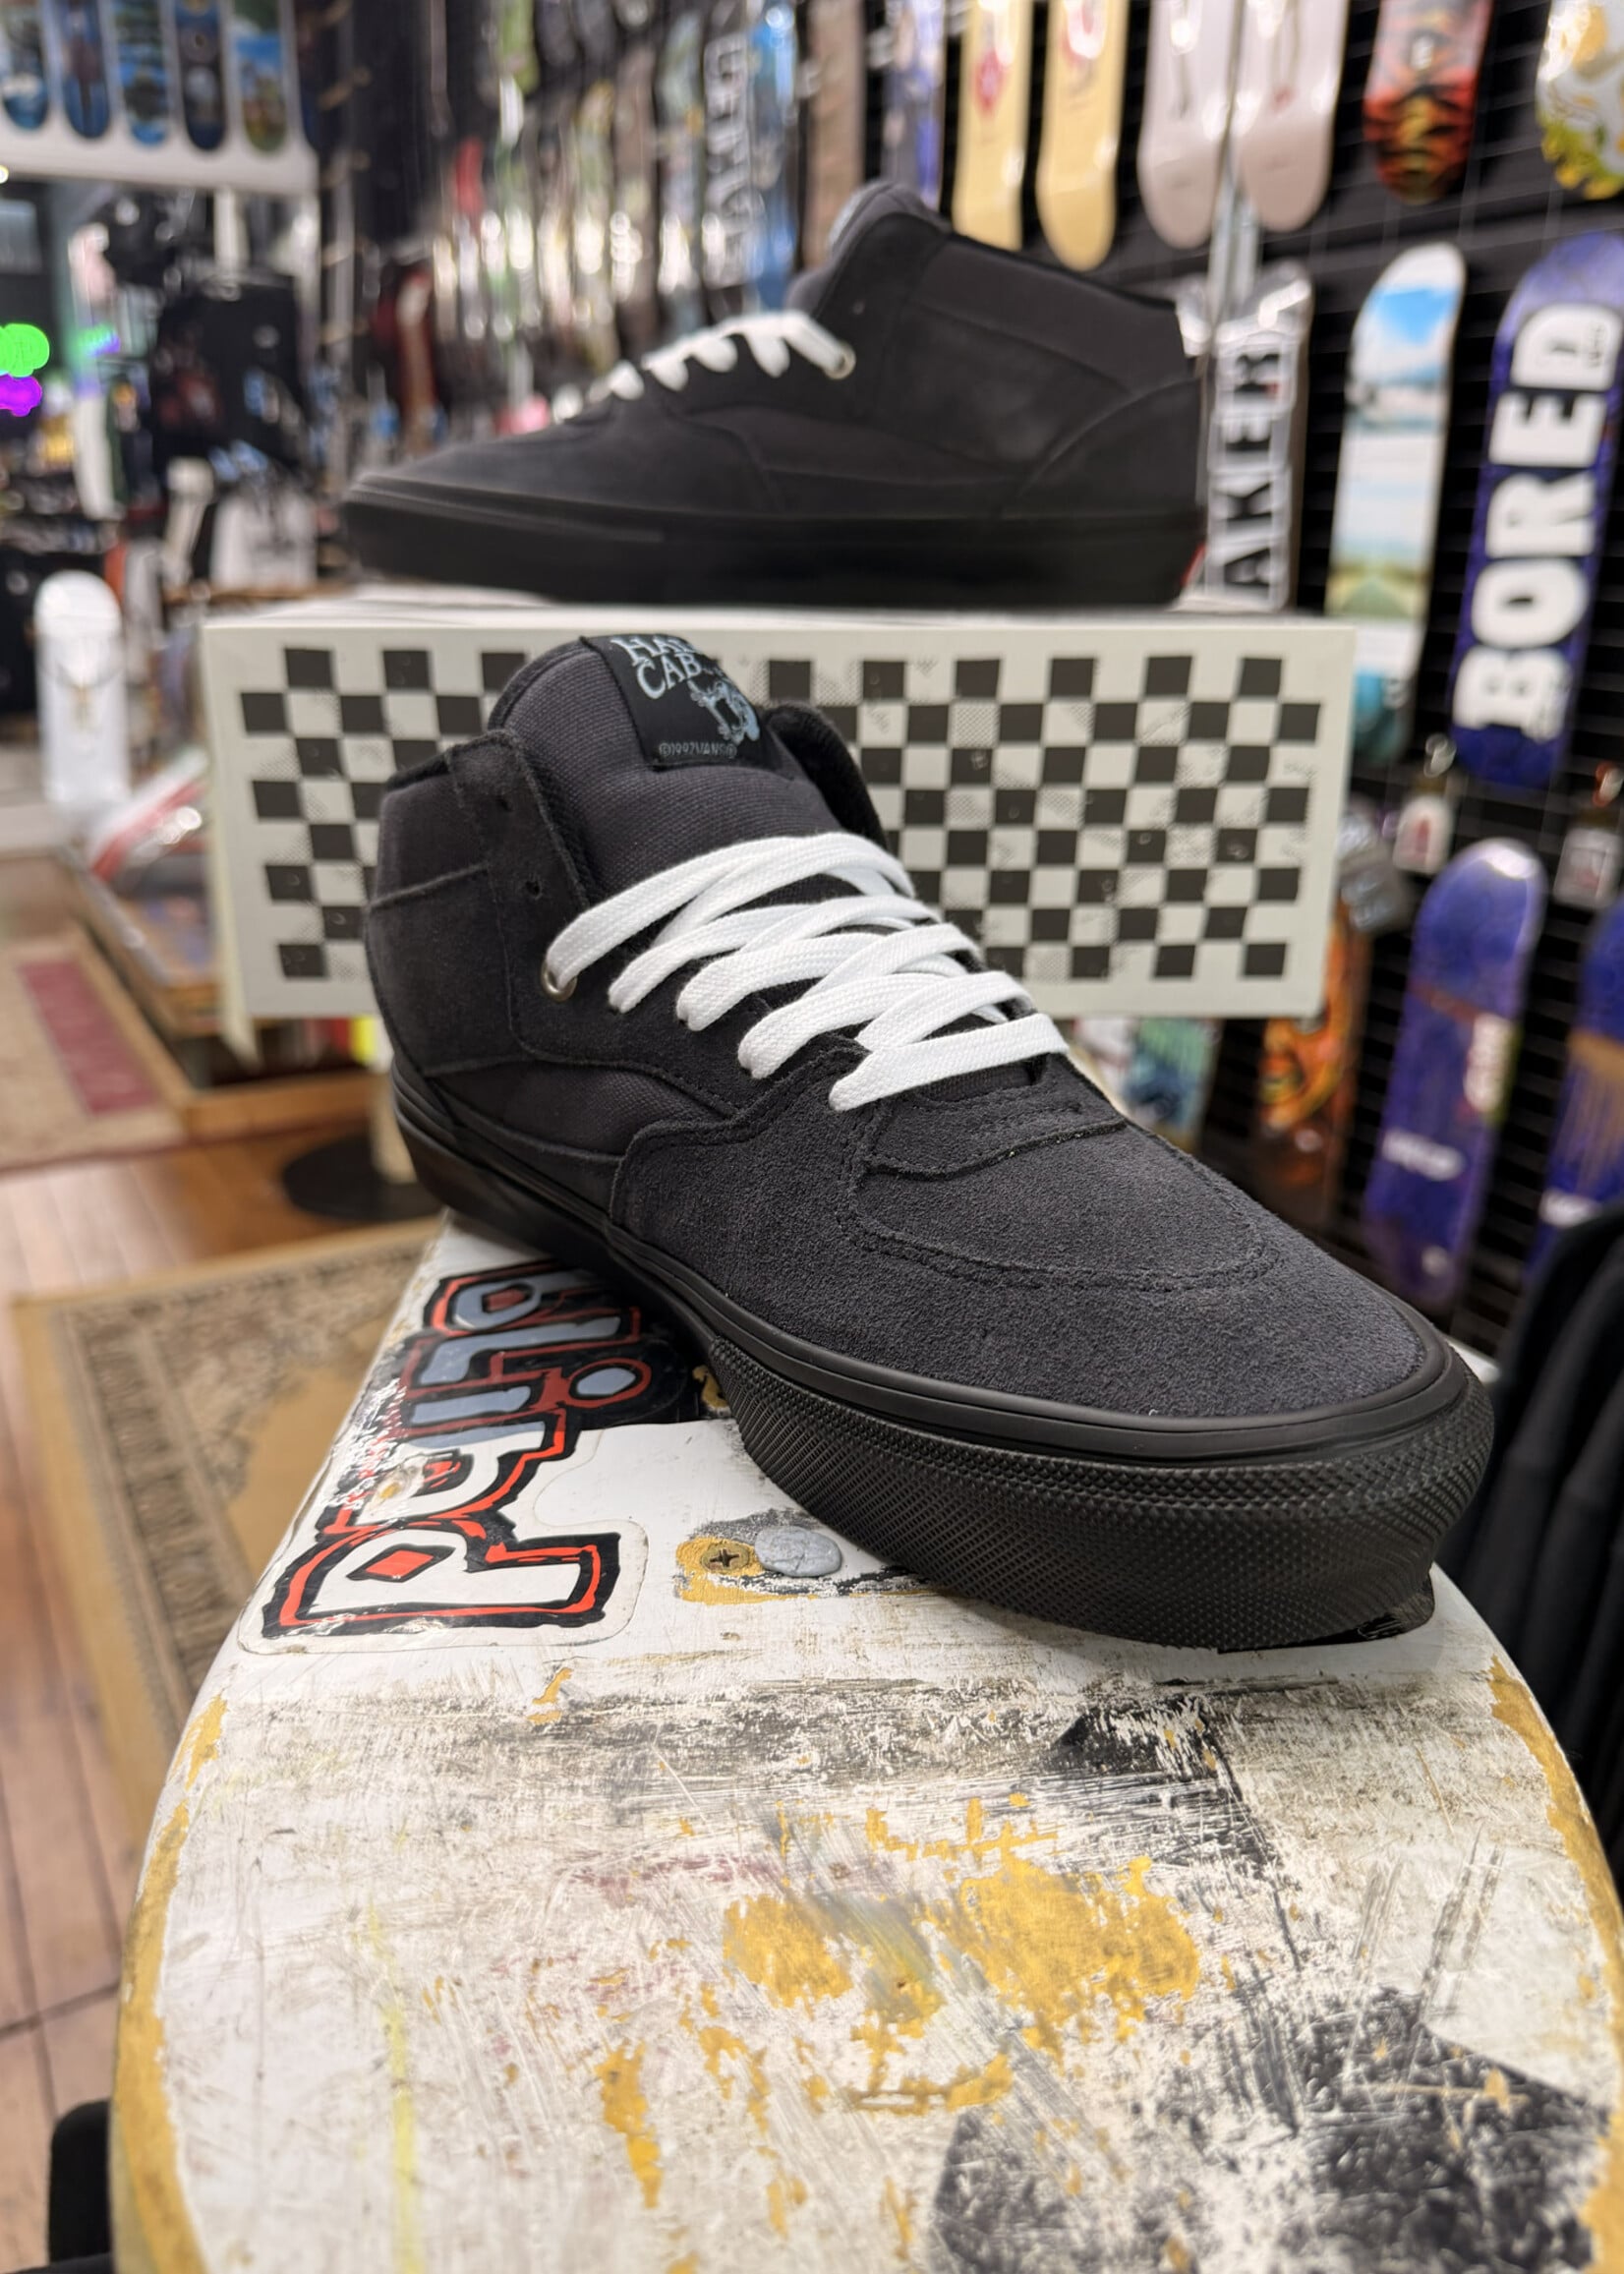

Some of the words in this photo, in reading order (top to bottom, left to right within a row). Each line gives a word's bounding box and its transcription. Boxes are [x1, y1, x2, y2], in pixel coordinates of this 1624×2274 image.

[1215, 340, 1287, 607] AKER
[1453, 303, 1620, 743] BORED
[637, 653, 702, 699] CAB
